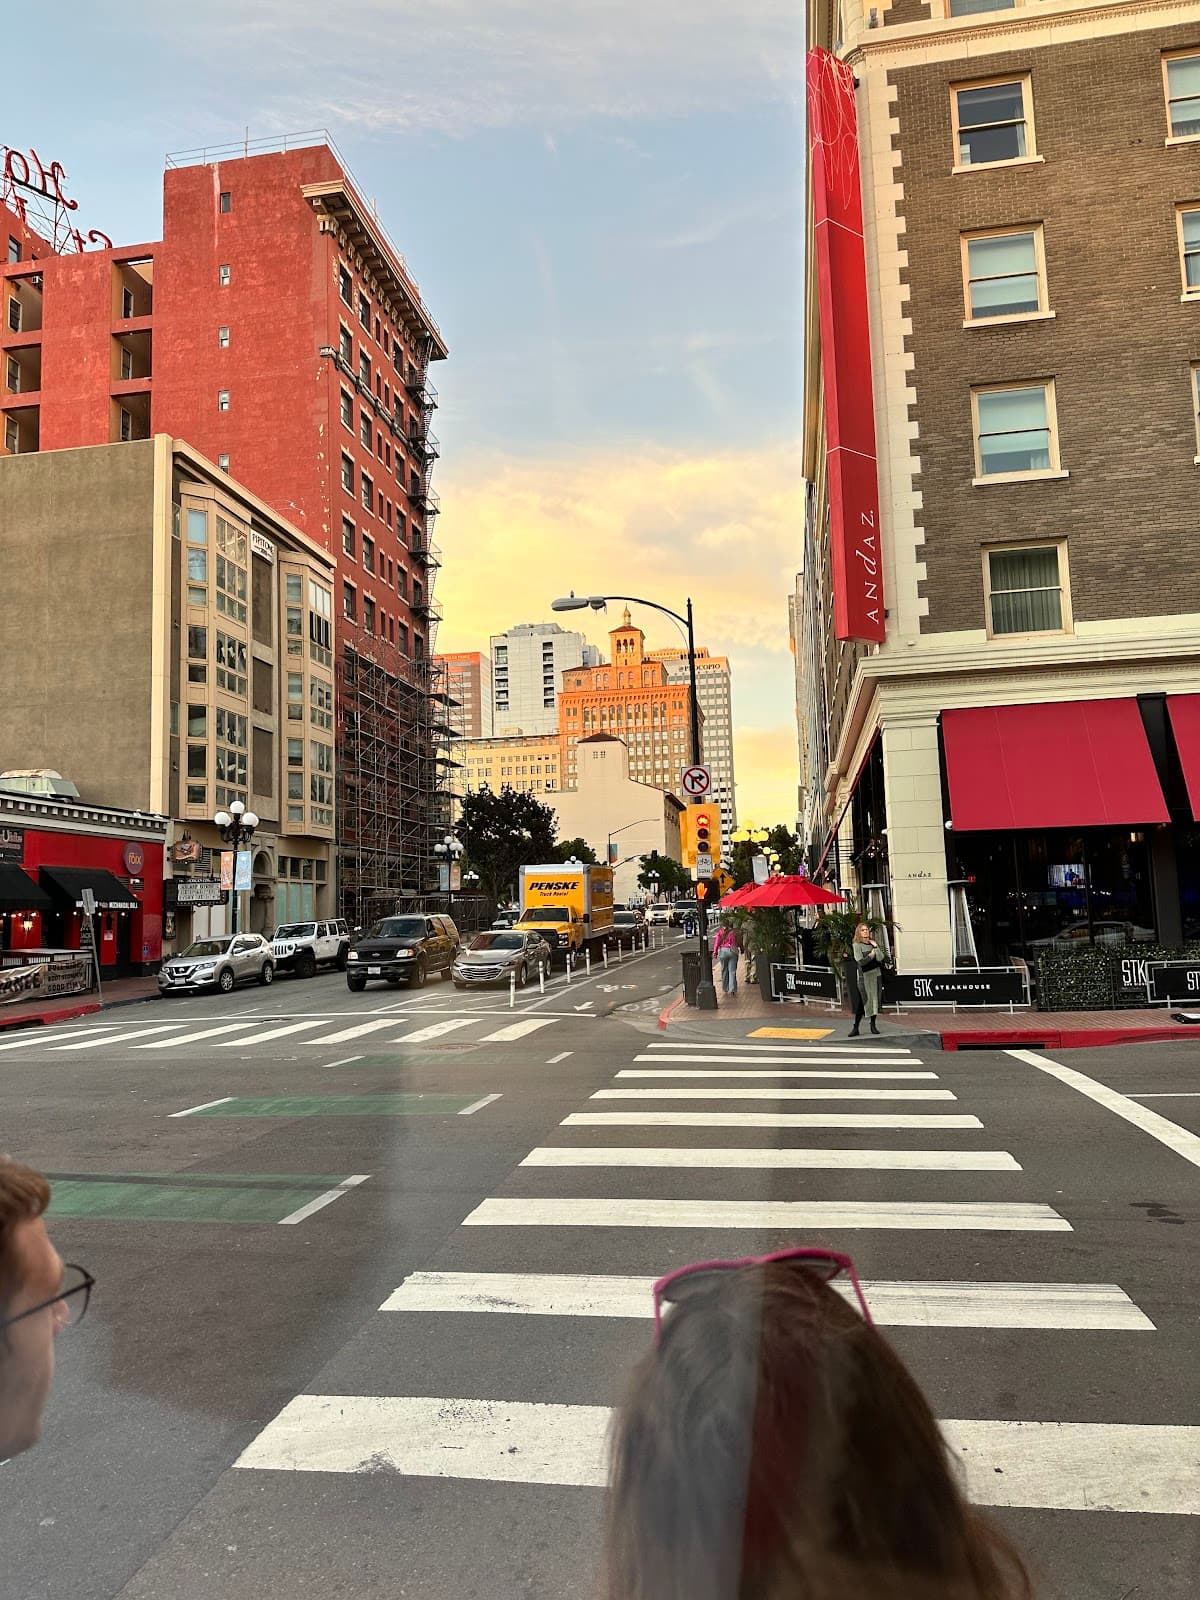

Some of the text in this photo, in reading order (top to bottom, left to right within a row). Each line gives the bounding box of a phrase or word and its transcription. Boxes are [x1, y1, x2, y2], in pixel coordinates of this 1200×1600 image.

[529, 882, 580, 890] PENSKE
[1121, 959, 1148, 983] STK
[914, 978, 934, 997] STK
